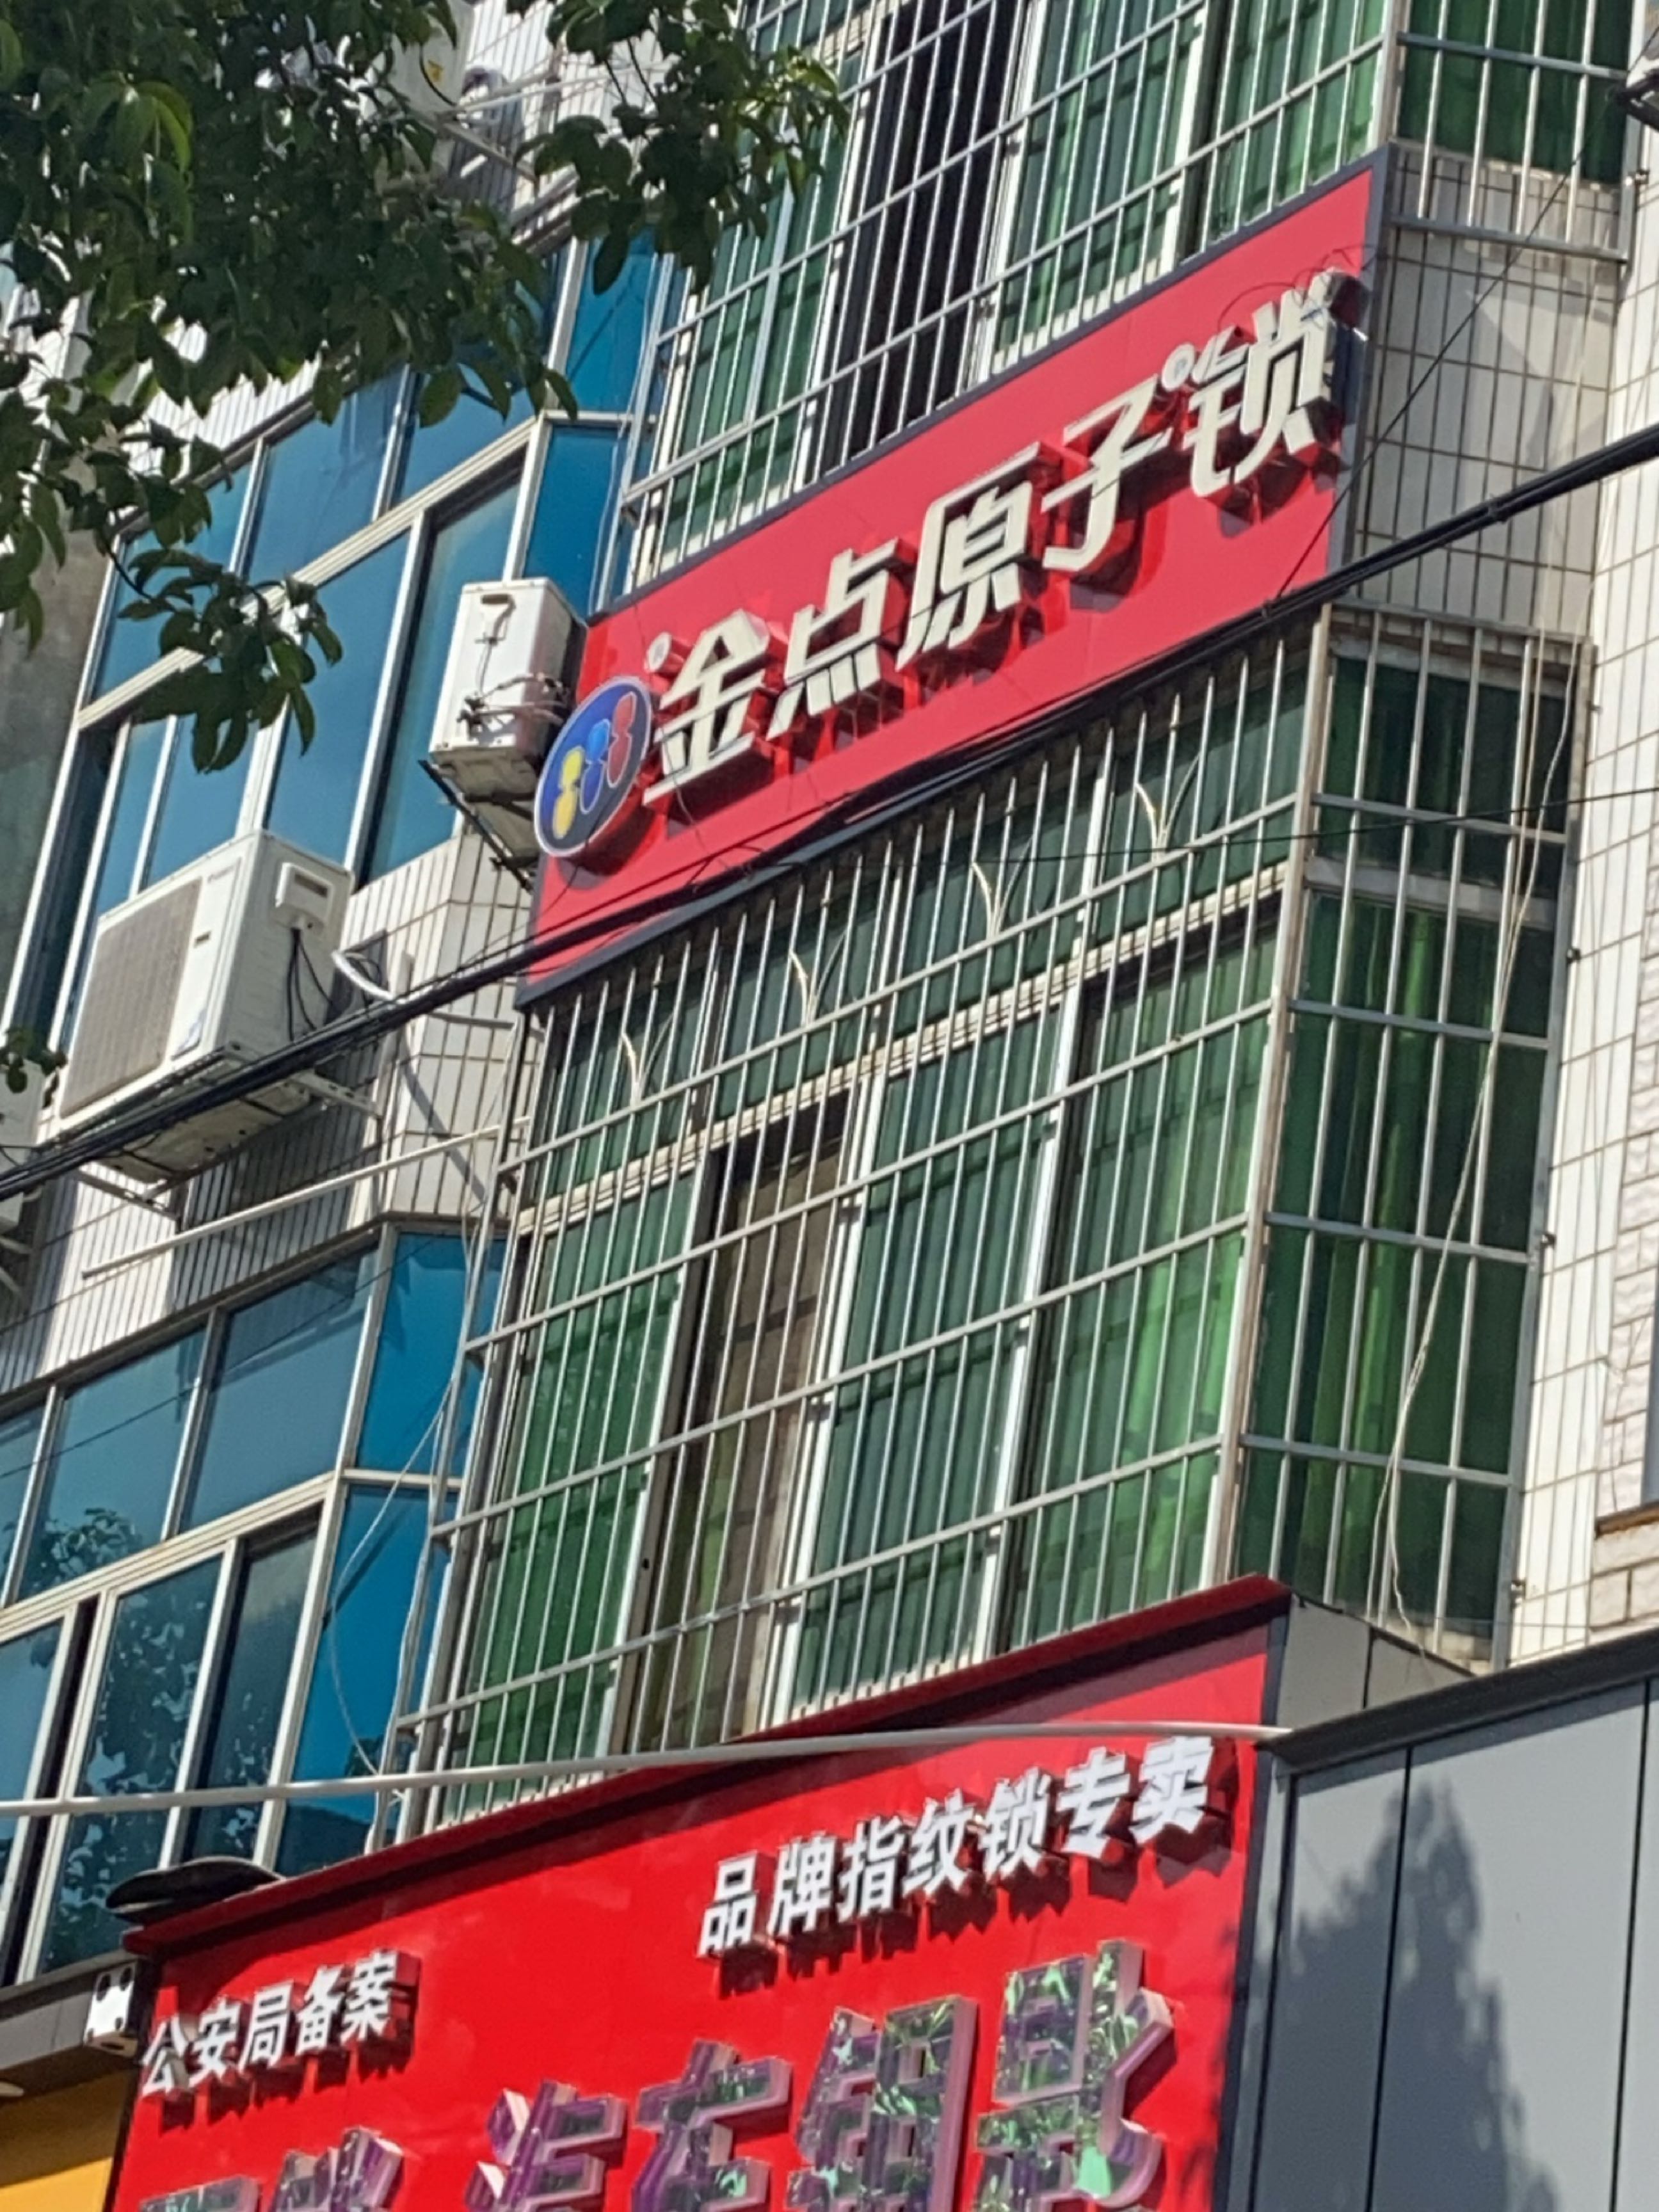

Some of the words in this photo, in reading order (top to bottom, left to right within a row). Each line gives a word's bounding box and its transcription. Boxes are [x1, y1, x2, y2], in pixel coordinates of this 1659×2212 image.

[643, 268, 1331, 806] 金点原子锁
[696, 1736, 1214, 1959] 品牌指纹锁专卖
[141, 1949, 399, 2095] 公安局备案
